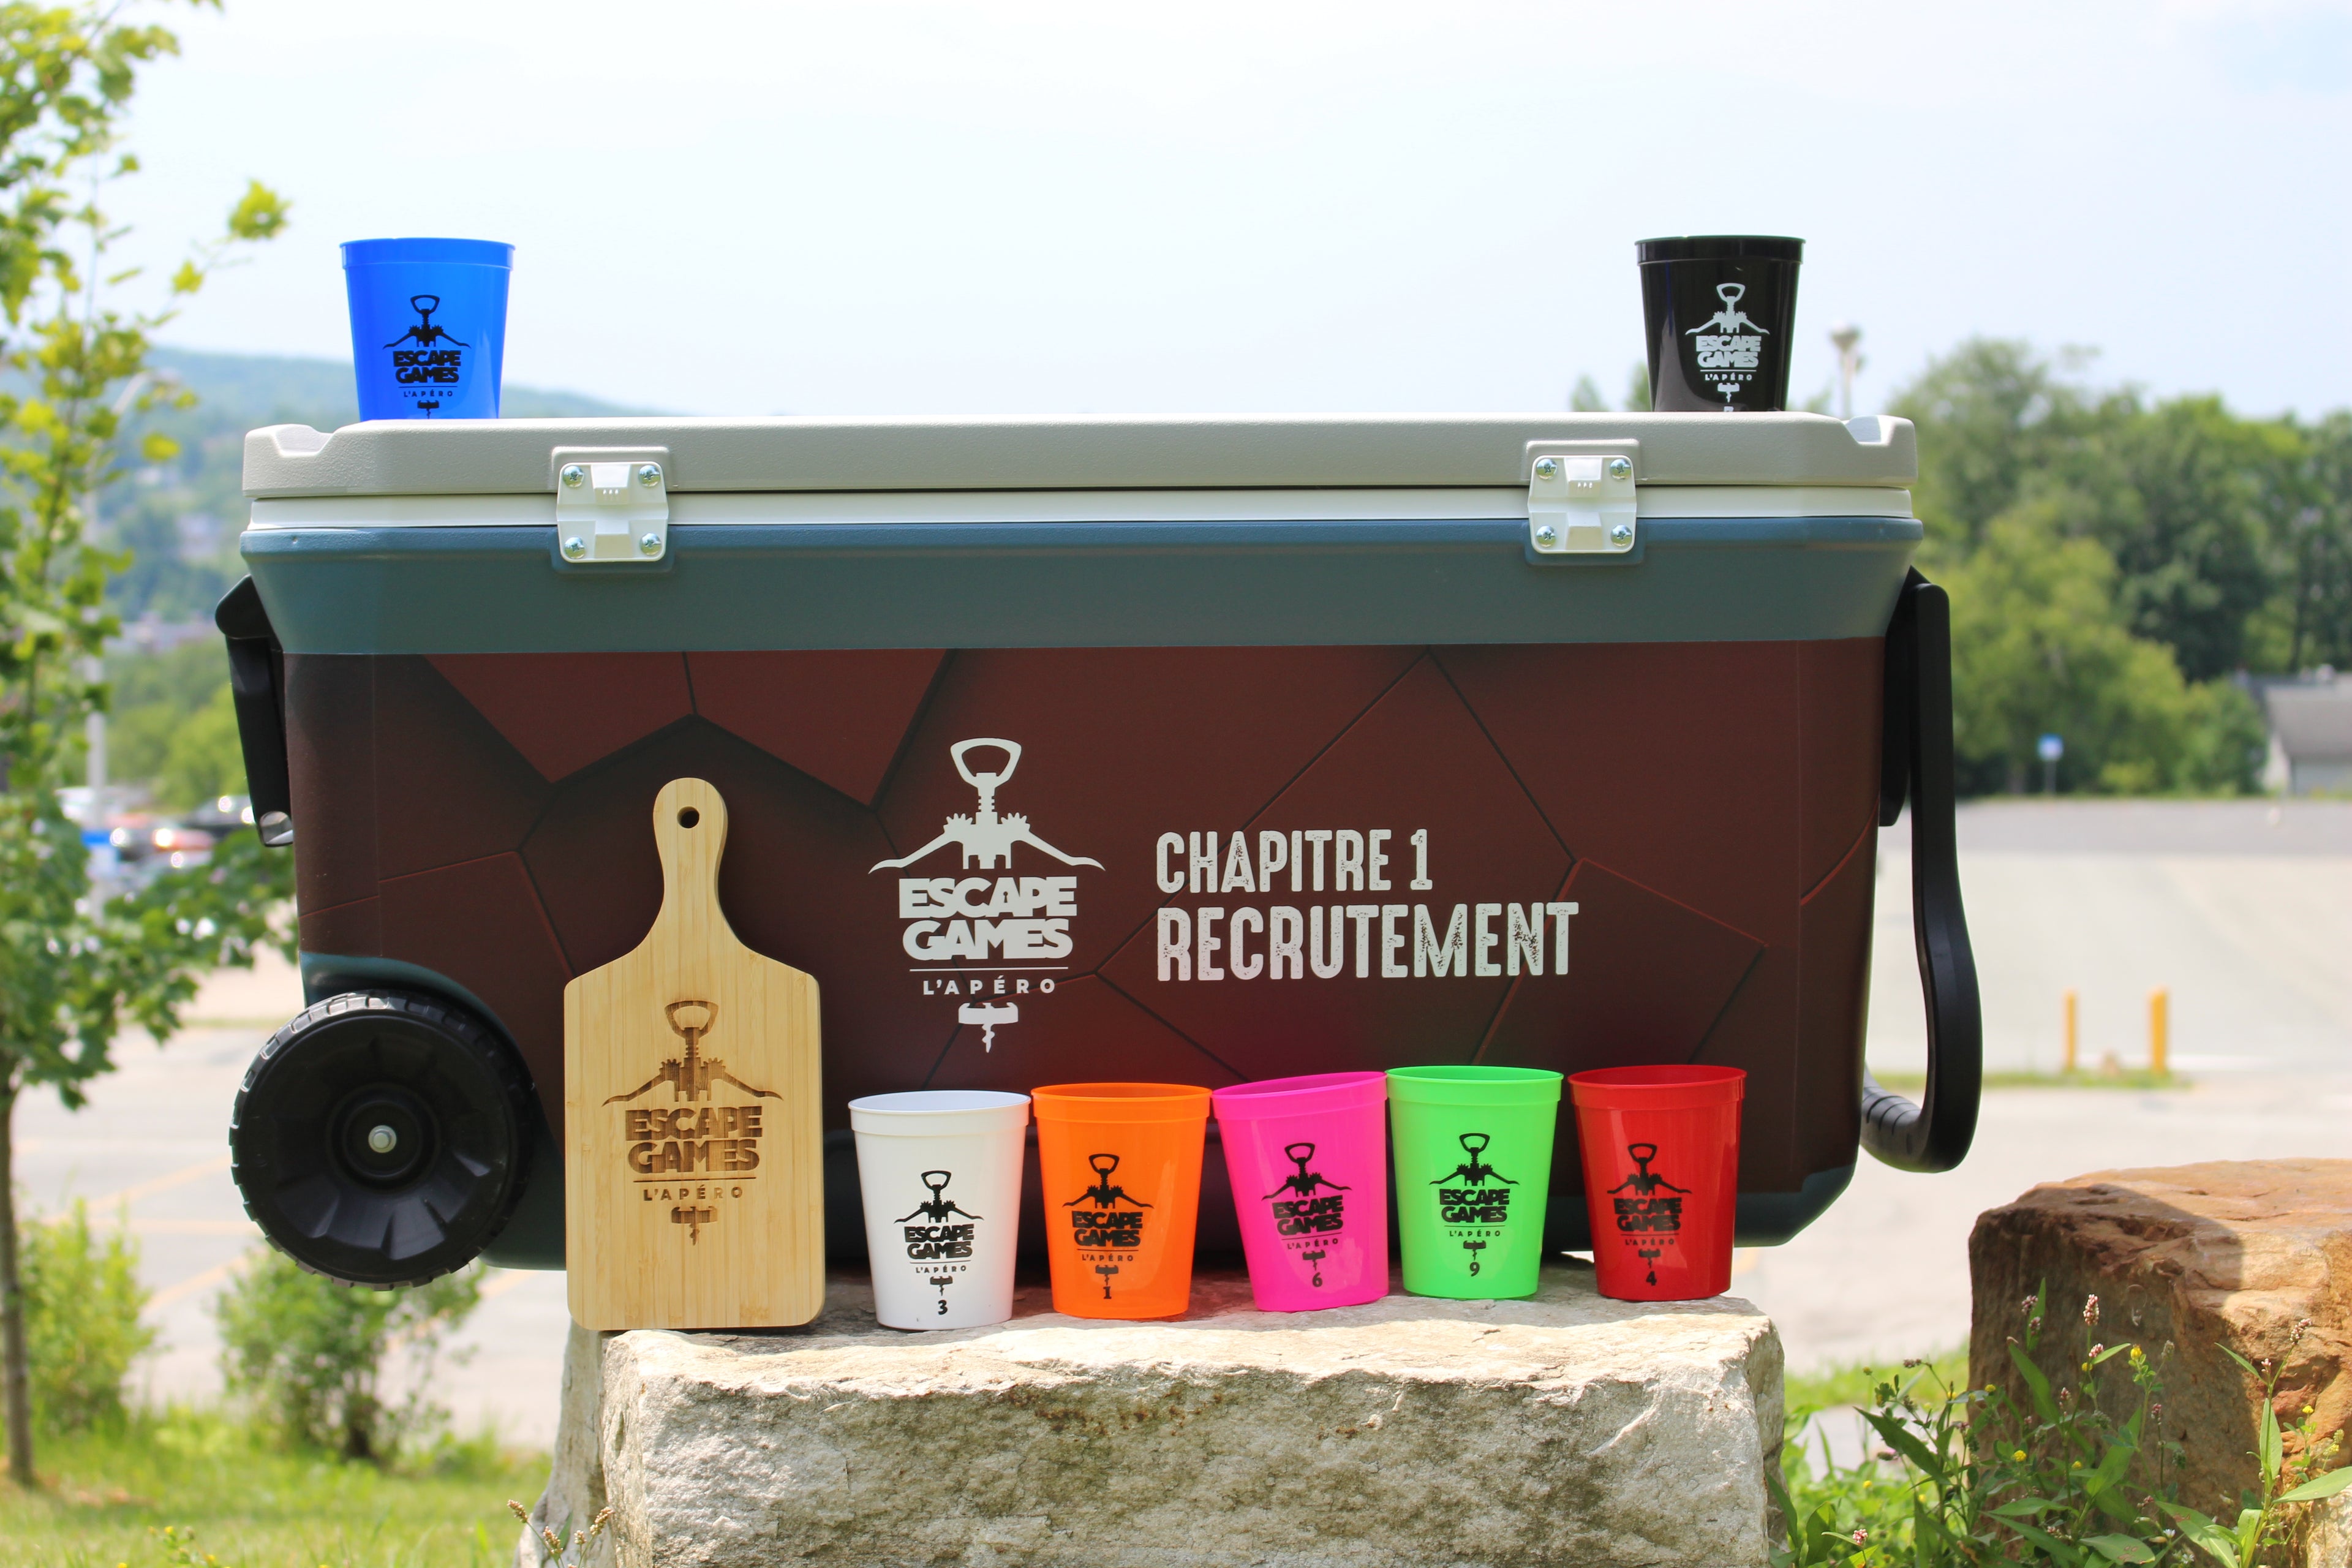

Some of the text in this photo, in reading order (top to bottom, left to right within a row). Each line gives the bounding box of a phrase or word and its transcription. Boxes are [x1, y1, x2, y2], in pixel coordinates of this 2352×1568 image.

[1696, 336, 1762, 352] ESCAPE
[393, 350, 461, 367] ESCAPE
[1697, 351, 1758, 368] GAMES
[396, 367, 459, 383] GAMES
[1705, 372, 1752, 381] L'APÉRO
[1156, 828, 1433, 894] CHAPITRE 1
[899, 876, 1077, 918] ESCAPE
[902, 918, 1073, 960] GAMES
[1157, 902, 1580, 981] RECRUTEMENT
[923, 975, 1055, 995] L'APÉRO
[625, 1106, 763, 1141] ESCAPE
[628, 1139, 760, 1174] GAMES
[643, 1185, 743, 1201] L'APÉRO
[1439, 1188, 1510, 1205] ESCAPE
[1272, 1195, 1344, 1219] ESCAPE
[1441, 1206, 1507, 1223] GAMES
[1613, 1197, 1682, 1215] ESCAPE
[1072, 1210, 1143, 1229] ESCAPE
[1277, 1213, 1343, 1235] GAMES
[1617, 1215, 1681, 1231] GAMES
[904, 1224, 974, 1243] ESCAPE
[1074, 1229, 1141, 1247] GAMES
[907, 1241, 973, 1259] GAMES
[1470, 1262, 1480, 1276] 9
[1312, 1272, 1322, 1287] 6
[1646, 1271, 1657, 1286] 4
[1103, 1286, 1112, 1299] 1
[938, 1300, 948, 1315] 3
